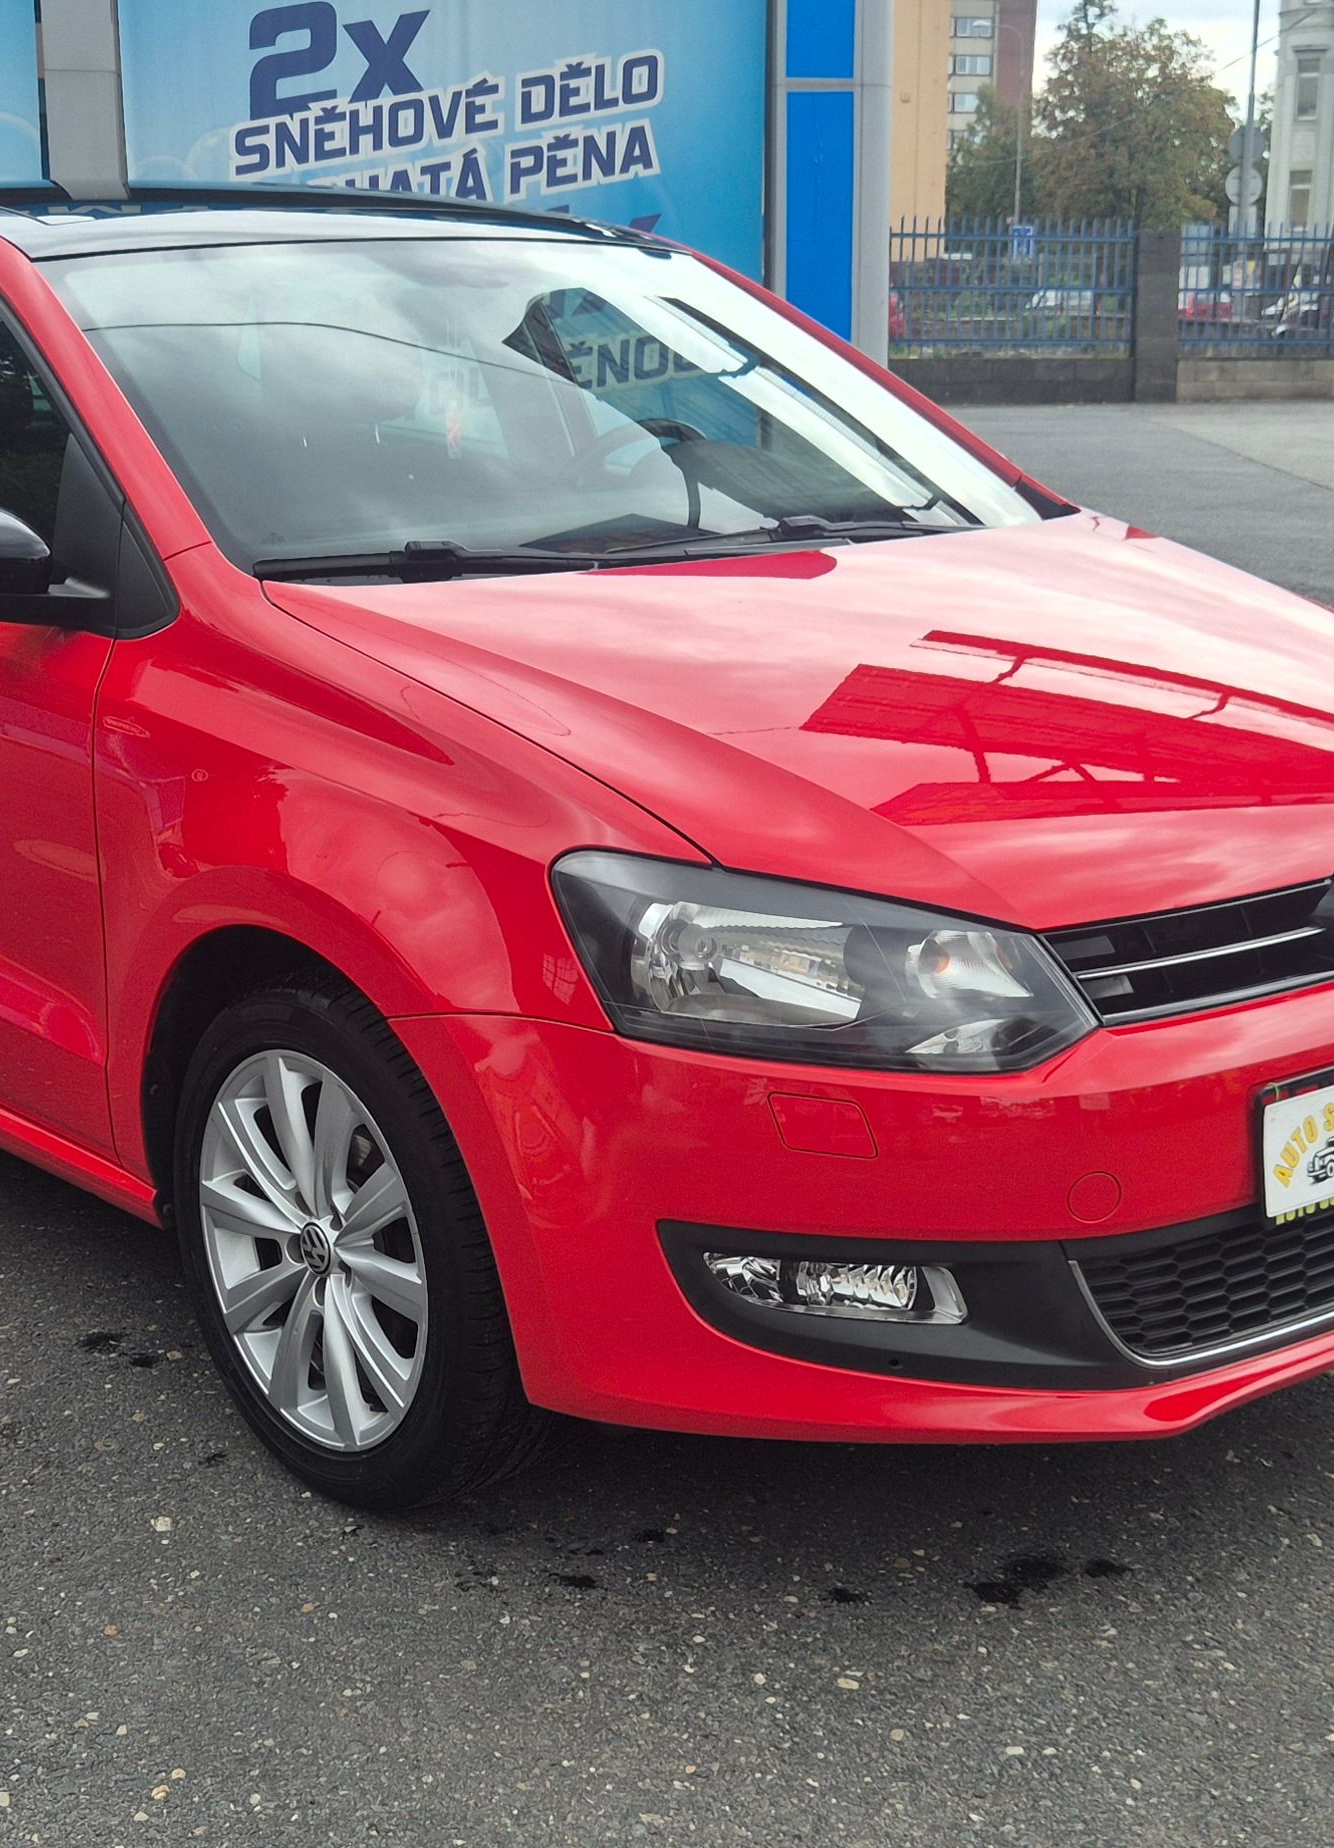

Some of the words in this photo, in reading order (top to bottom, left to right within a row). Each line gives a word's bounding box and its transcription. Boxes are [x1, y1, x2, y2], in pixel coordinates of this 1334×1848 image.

[234, 78, 499, 176] SNĚHOVÉ
[521, 55, 659, 126] DĚLO
[510, 126, 653, 195] PĚNA
[1273, 1115, 1319, 1188] AUTO
